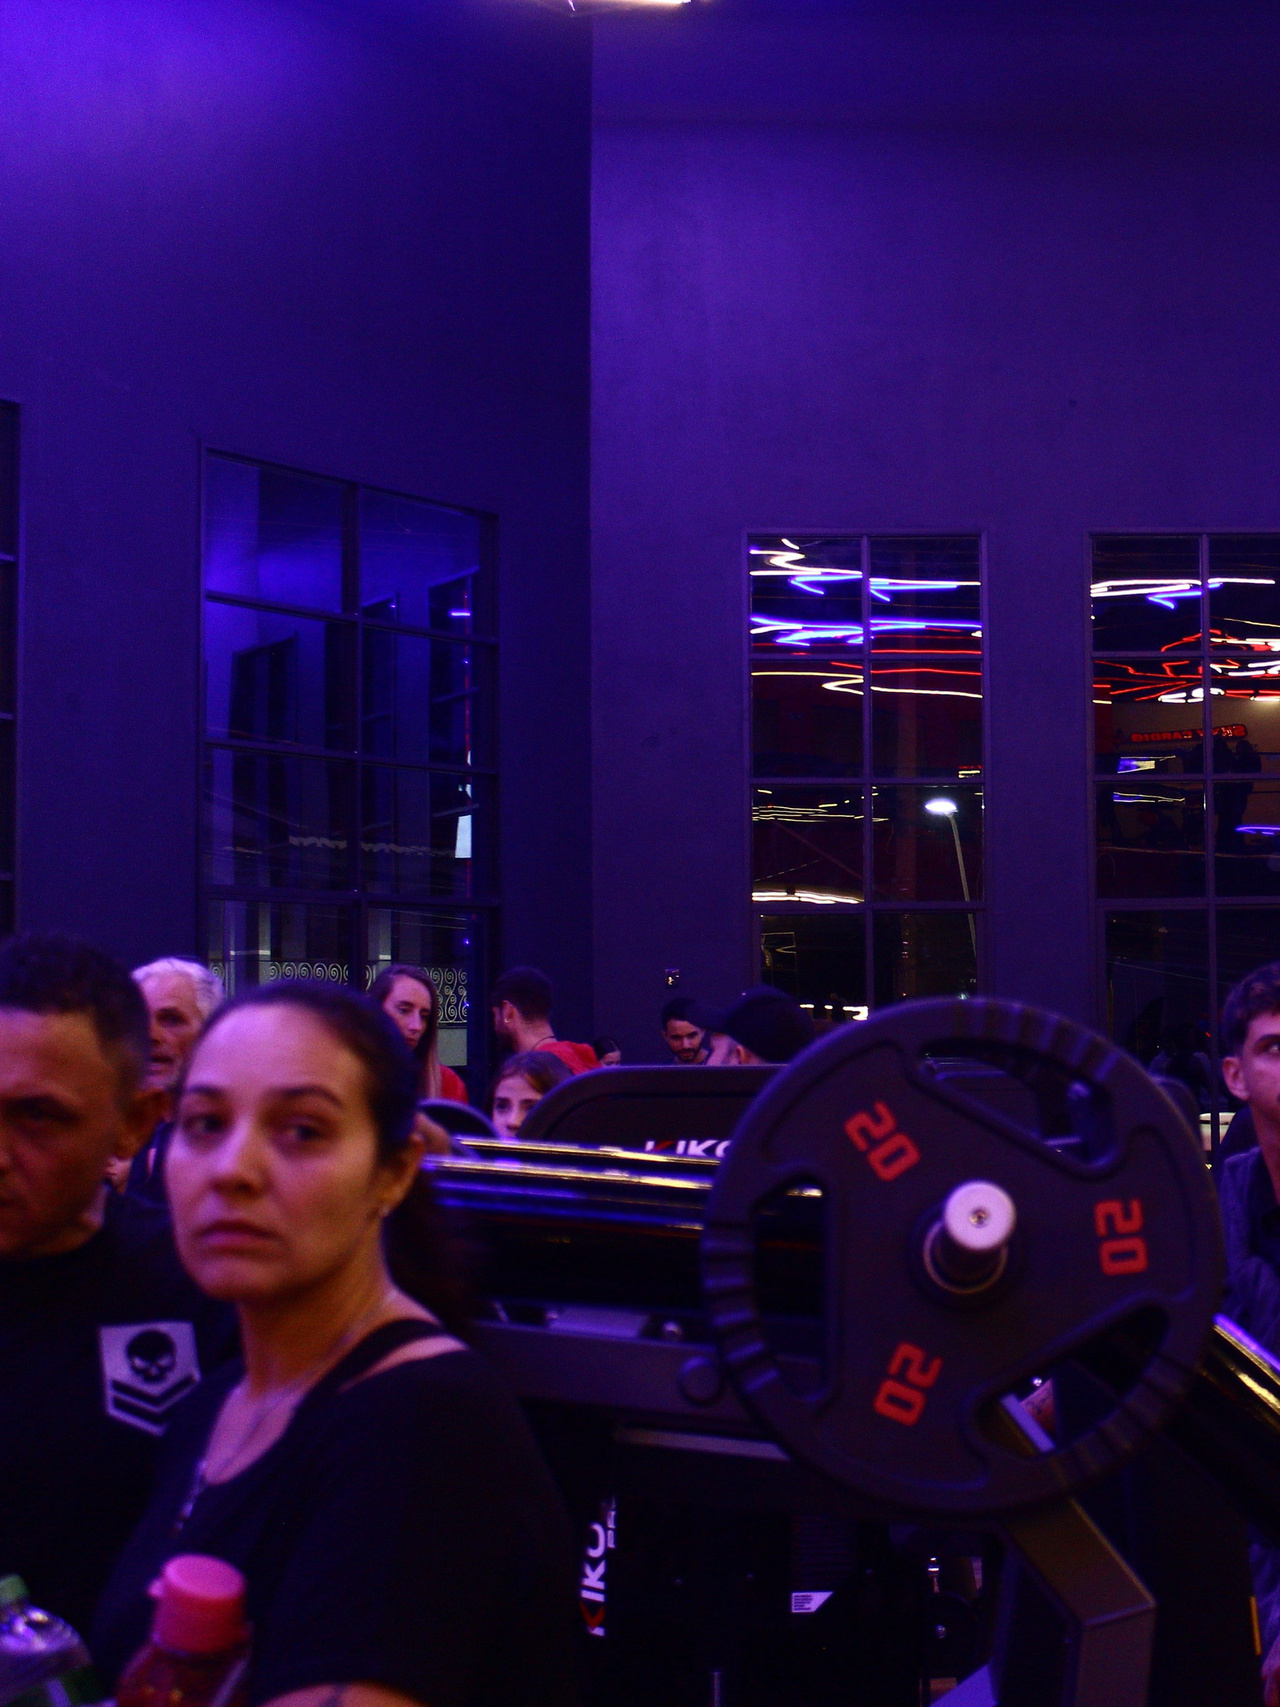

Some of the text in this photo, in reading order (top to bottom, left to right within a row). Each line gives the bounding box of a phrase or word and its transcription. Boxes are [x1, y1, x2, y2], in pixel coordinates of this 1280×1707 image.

[844, 1100, 921, 1181] 20
[1093, 1197, 1149, 1276] 20
[873, 1341, 944, 1426] 20
